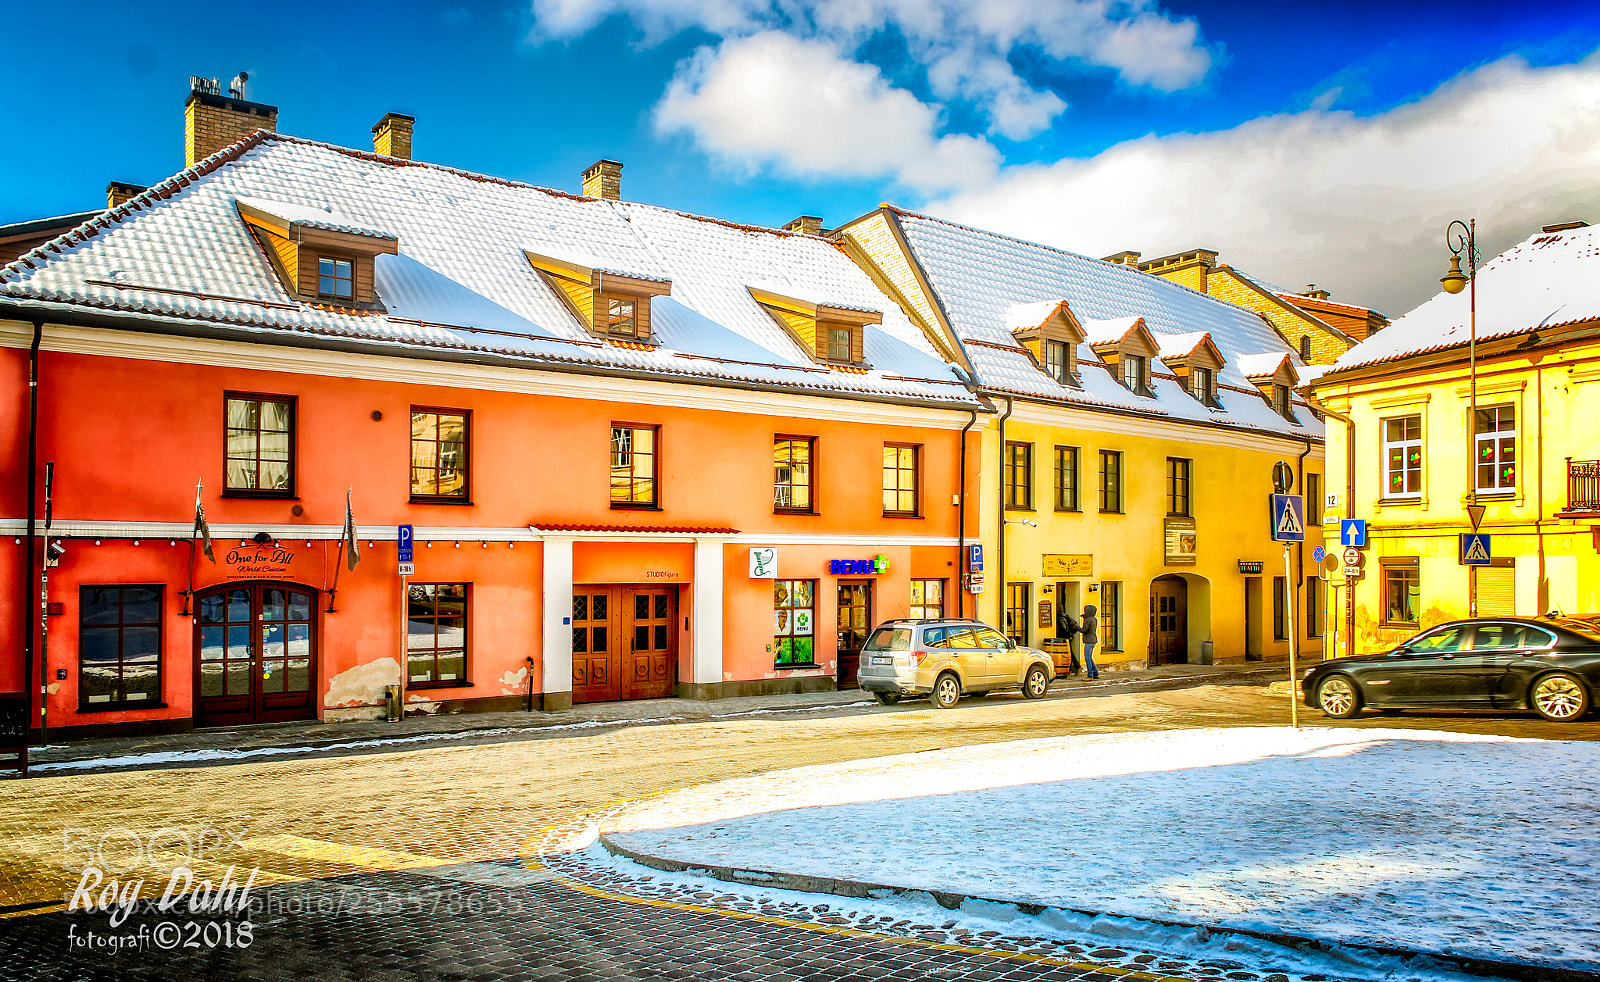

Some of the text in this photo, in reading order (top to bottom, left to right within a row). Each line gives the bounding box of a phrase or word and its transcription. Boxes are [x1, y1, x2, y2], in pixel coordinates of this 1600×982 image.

[1328, 495, 1335, 505] 12
[401, 527, 410, 547] P
[226, 549, 295, 565] One for All
[973, 546, 981, 561] P
[237, 565, 261, 573] World
[830, 559, 874, 574] BENU
